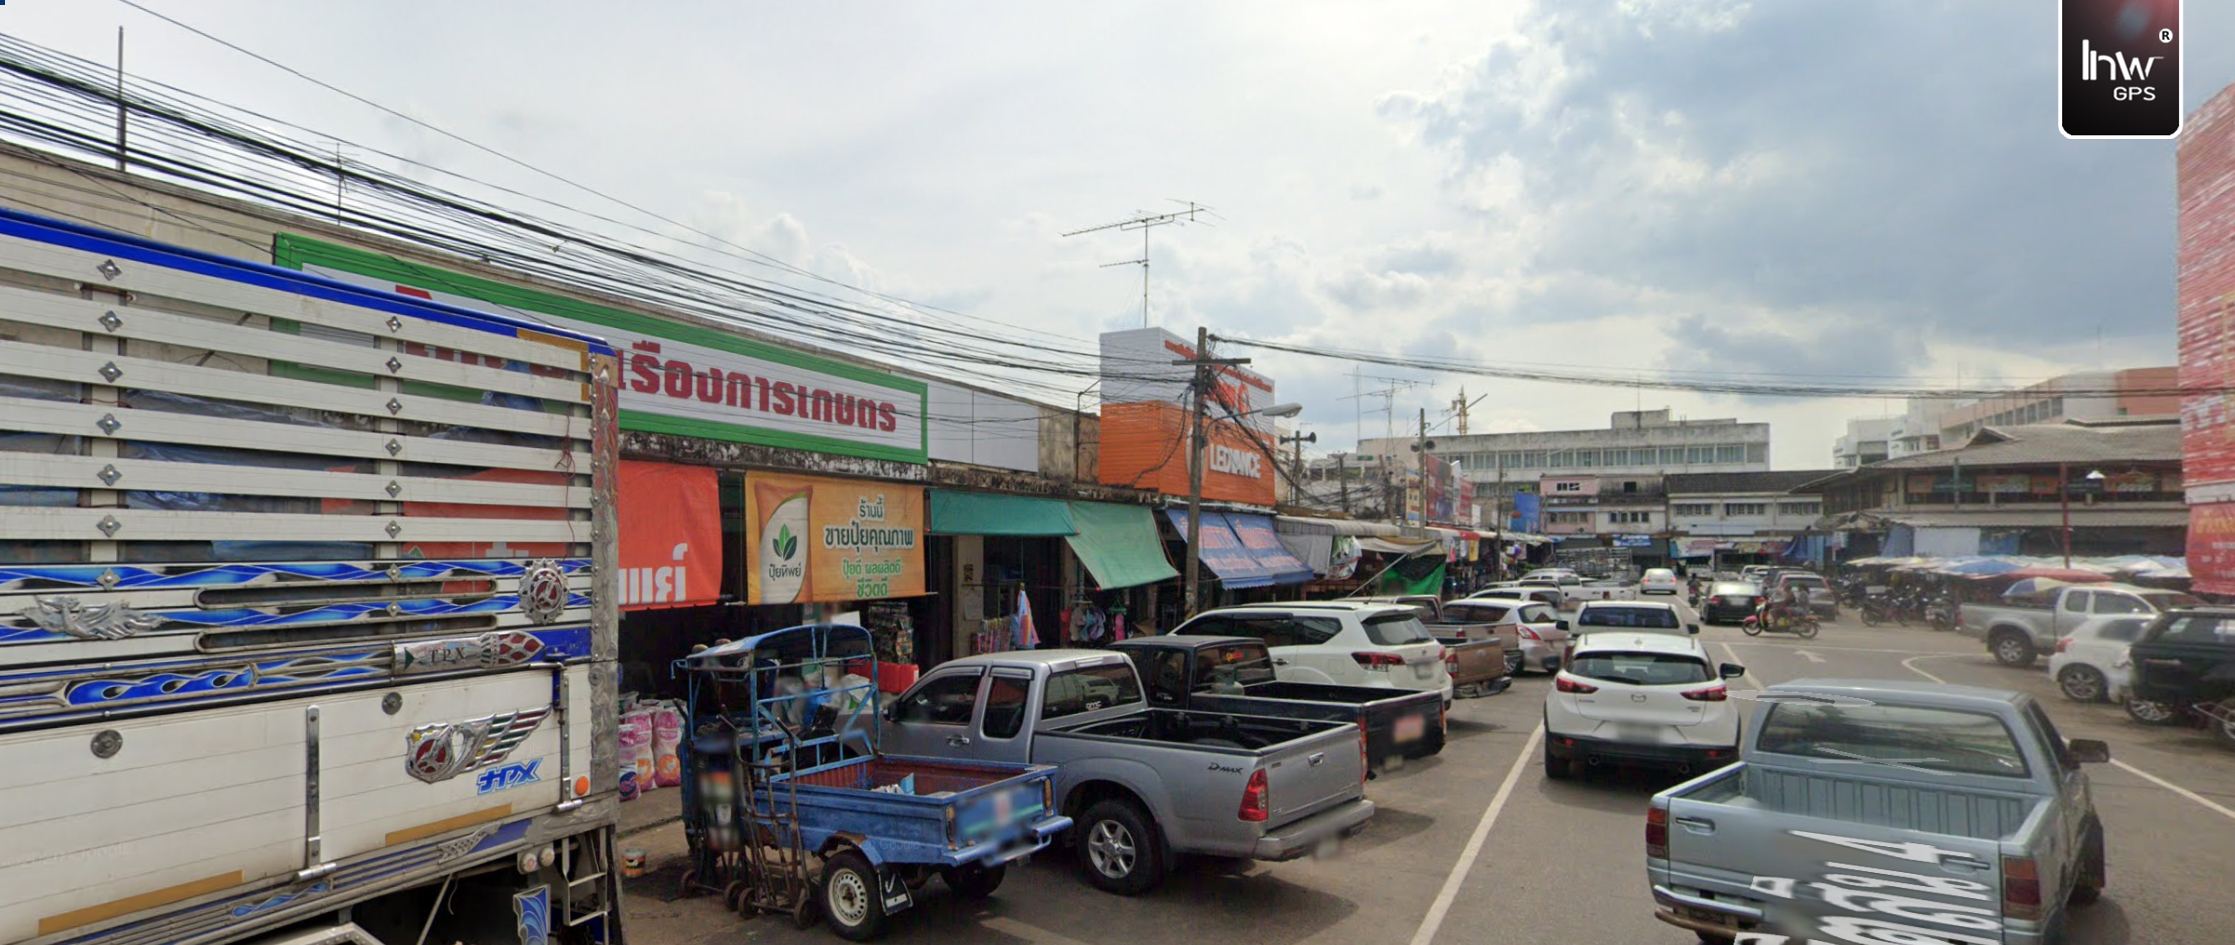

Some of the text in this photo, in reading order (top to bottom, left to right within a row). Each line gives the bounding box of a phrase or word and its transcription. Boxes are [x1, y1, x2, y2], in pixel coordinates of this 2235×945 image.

[859, 495, 885, 519] ร้านนี้
[825, 520, 914, 552] ขายปุ๋ยคุณภาพ
[857, 578, 889, 598] ชีวิตดี
[430, 646, 466, 663] TPX
